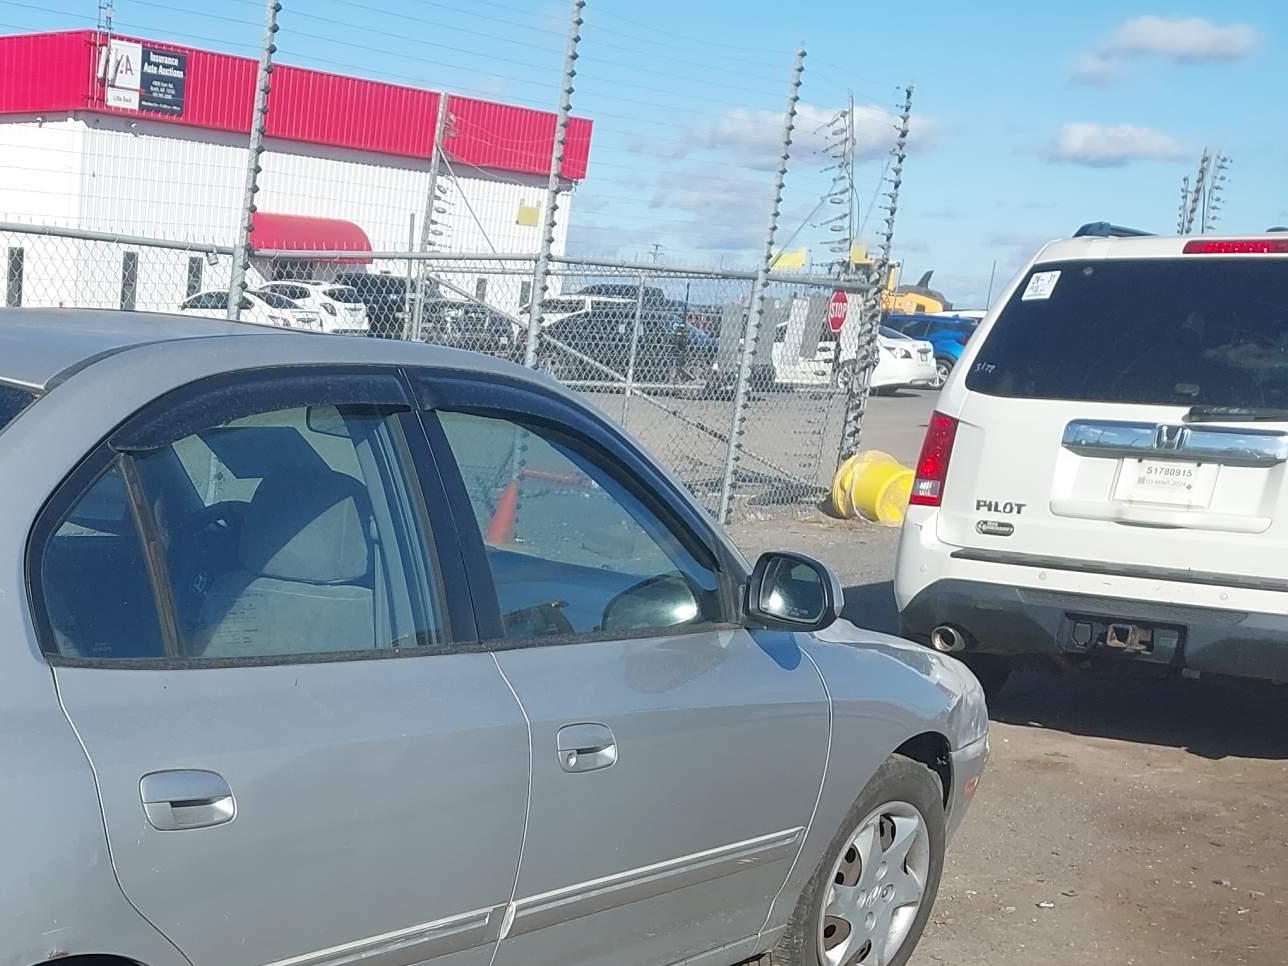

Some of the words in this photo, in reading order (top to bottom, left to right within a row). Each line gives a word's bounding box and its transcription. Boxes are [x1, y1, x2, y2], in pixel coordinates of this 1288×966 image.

[830, 302, 847, 318] STOP
[1145, 466, 1193, 478] S1780915
[975, 499, 1027, 515] PILOT
